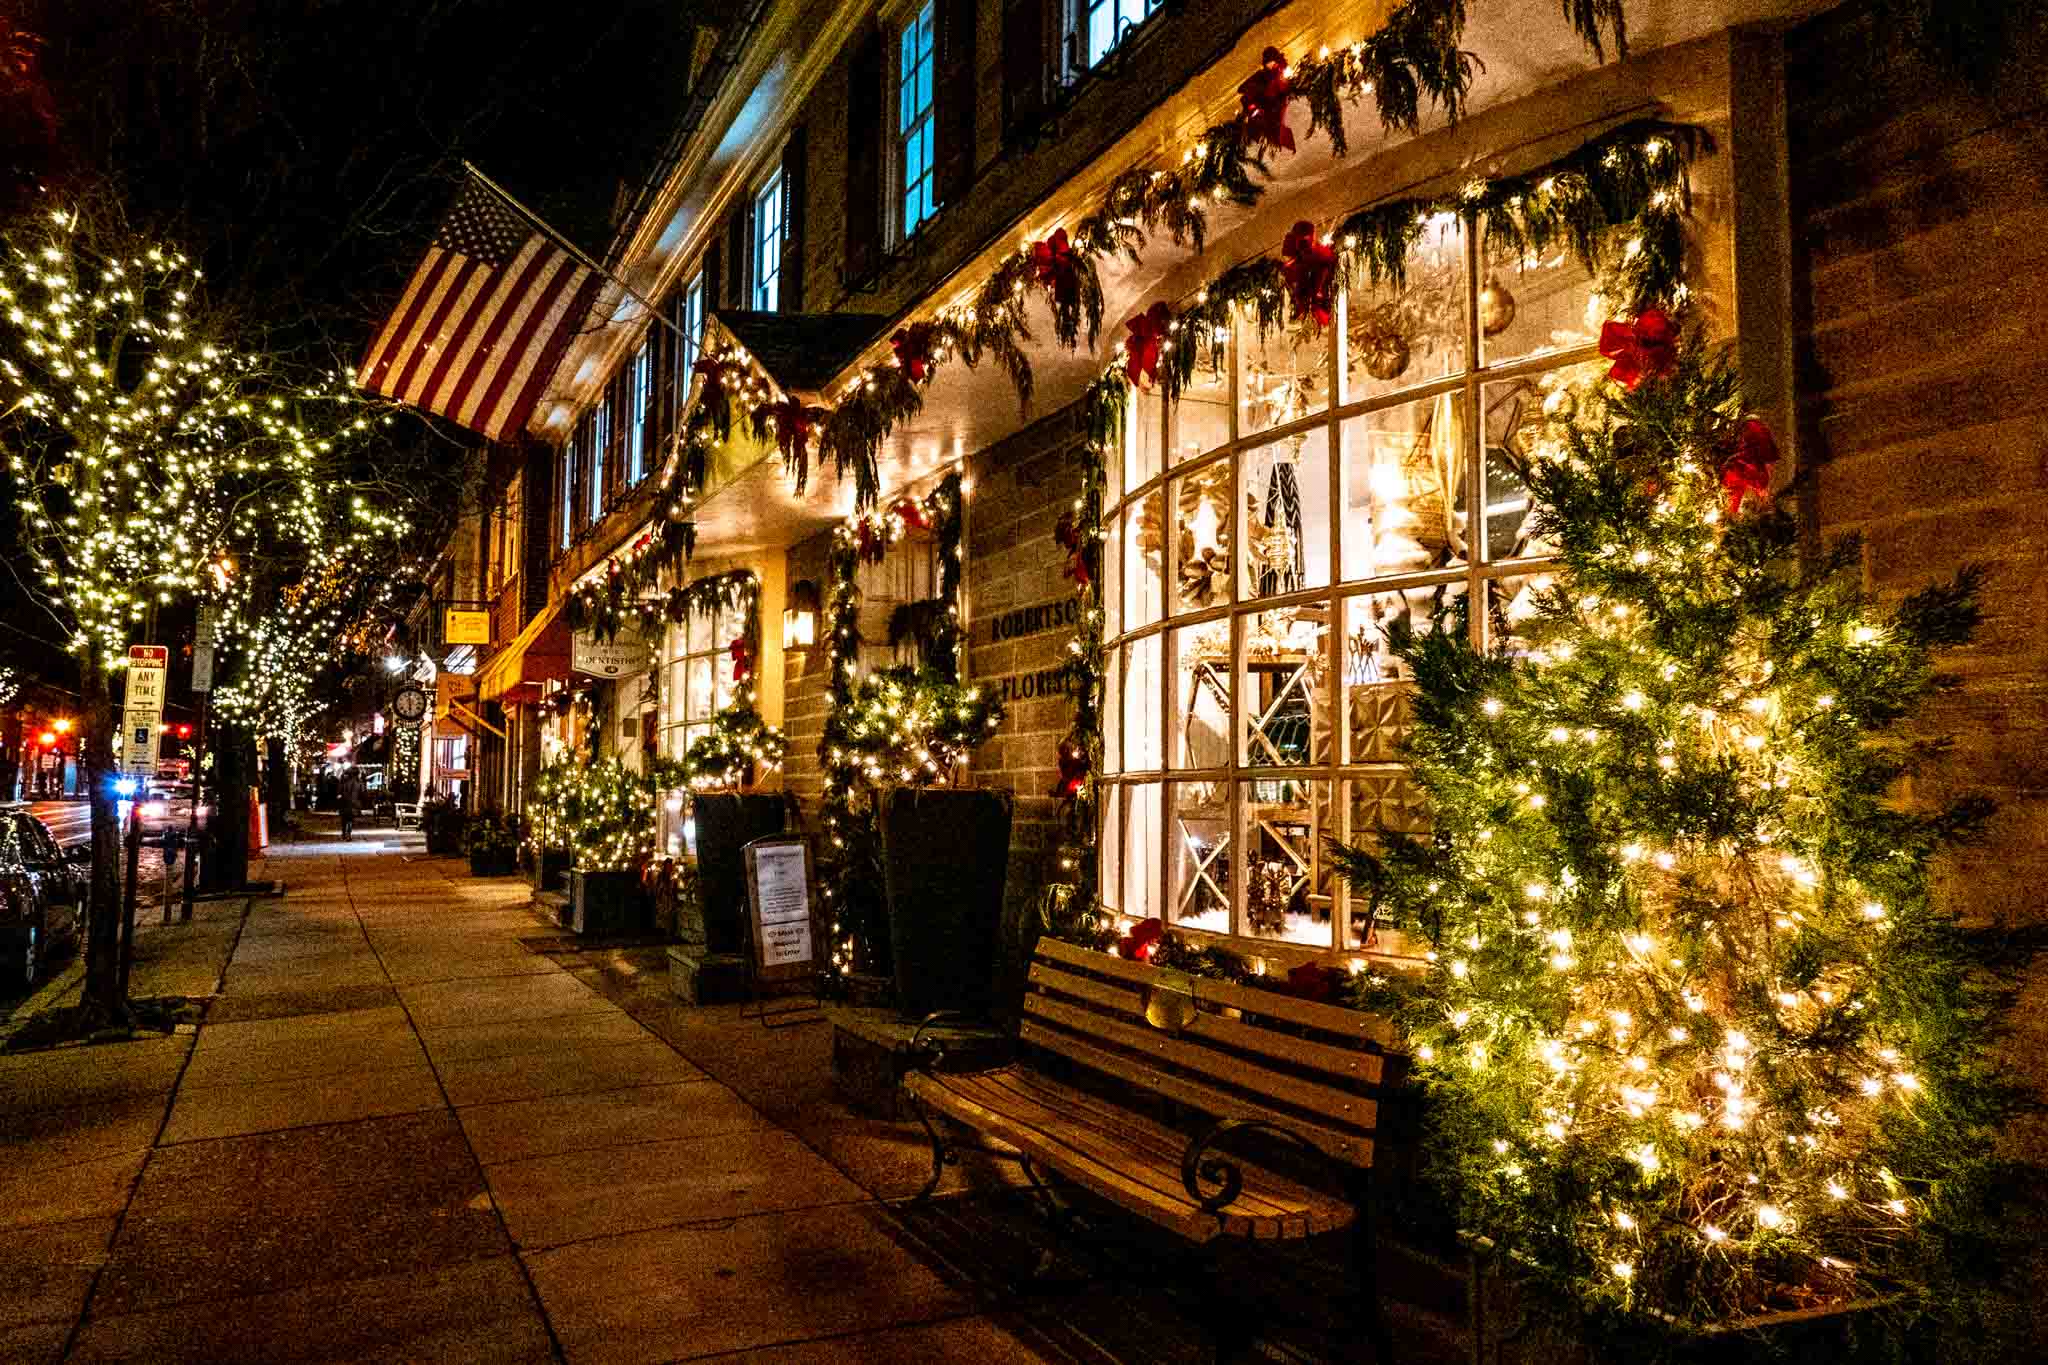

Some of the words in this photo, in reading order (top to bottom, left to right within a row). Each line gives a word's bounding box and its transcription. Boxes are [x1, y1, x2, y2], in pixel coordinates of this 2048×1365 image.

[992, 598, 1078, 641] ROBERTSO
[143, 648, 154, 657] NO
[132, 658, 164, 667] STOPPING
[137, 671, 156, 681] ANY
[135, 685, 157, 696] TIME
